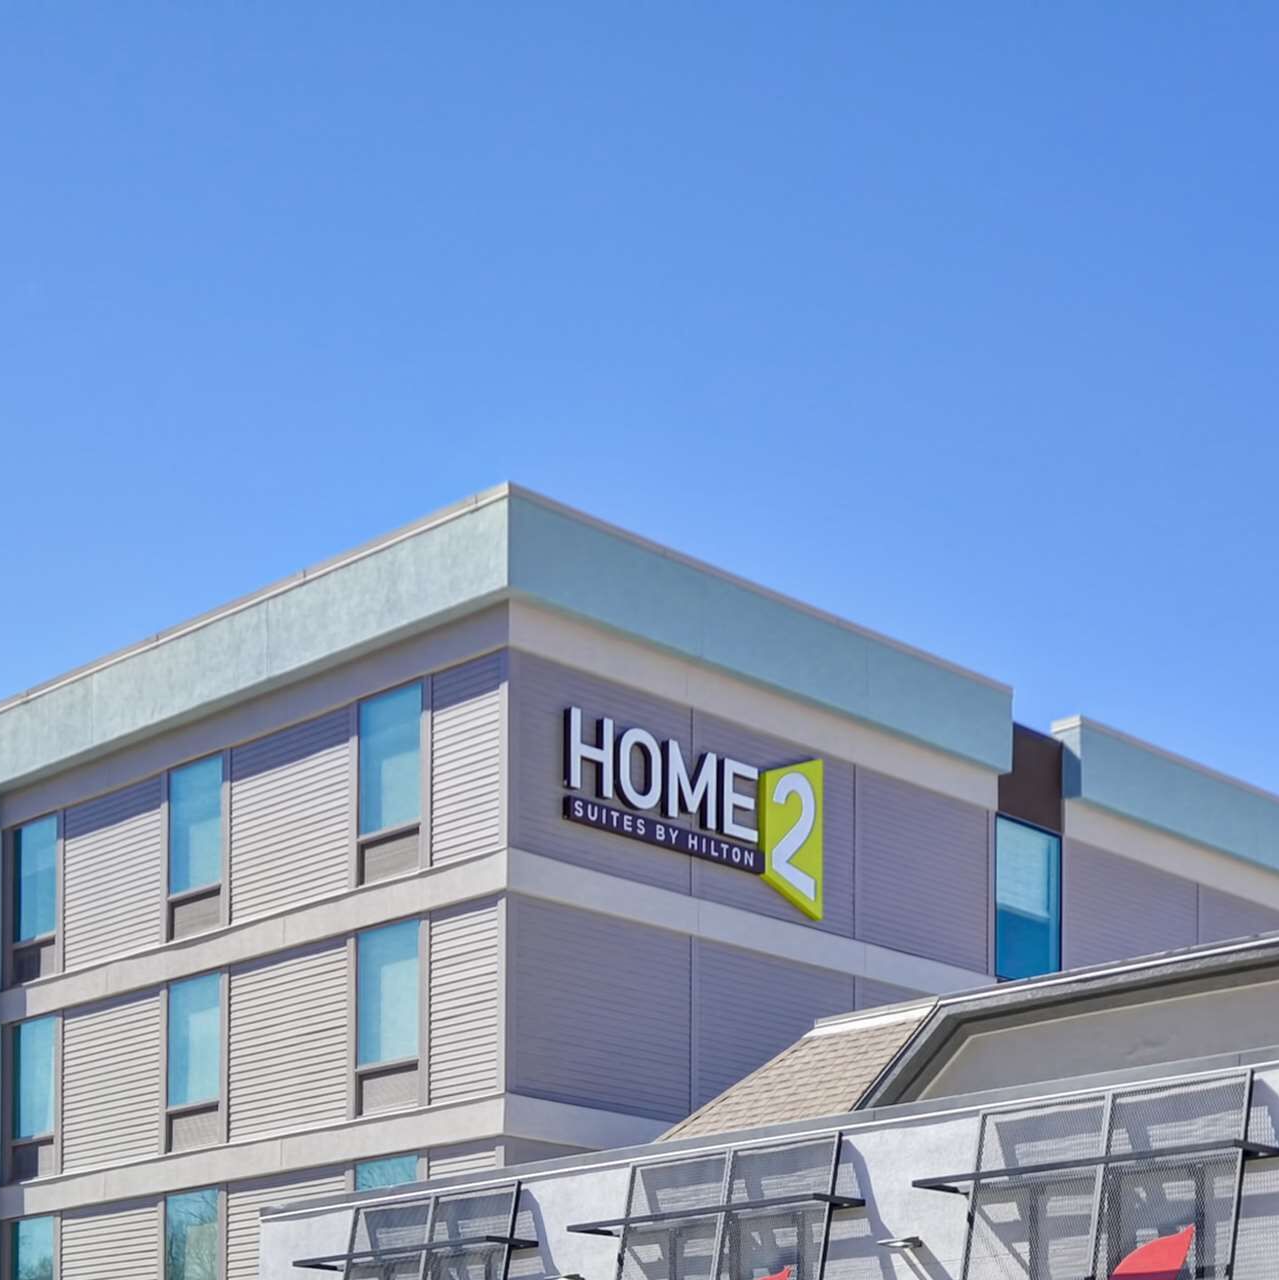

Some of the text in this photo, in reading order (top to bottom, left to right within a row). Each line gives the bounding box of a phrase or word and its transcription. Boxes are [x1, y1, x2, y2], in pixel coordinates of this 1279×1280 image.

[567, 706, 816, 902] HOME 2
[574, 800, 755, 867] SUITES BY HILTON
